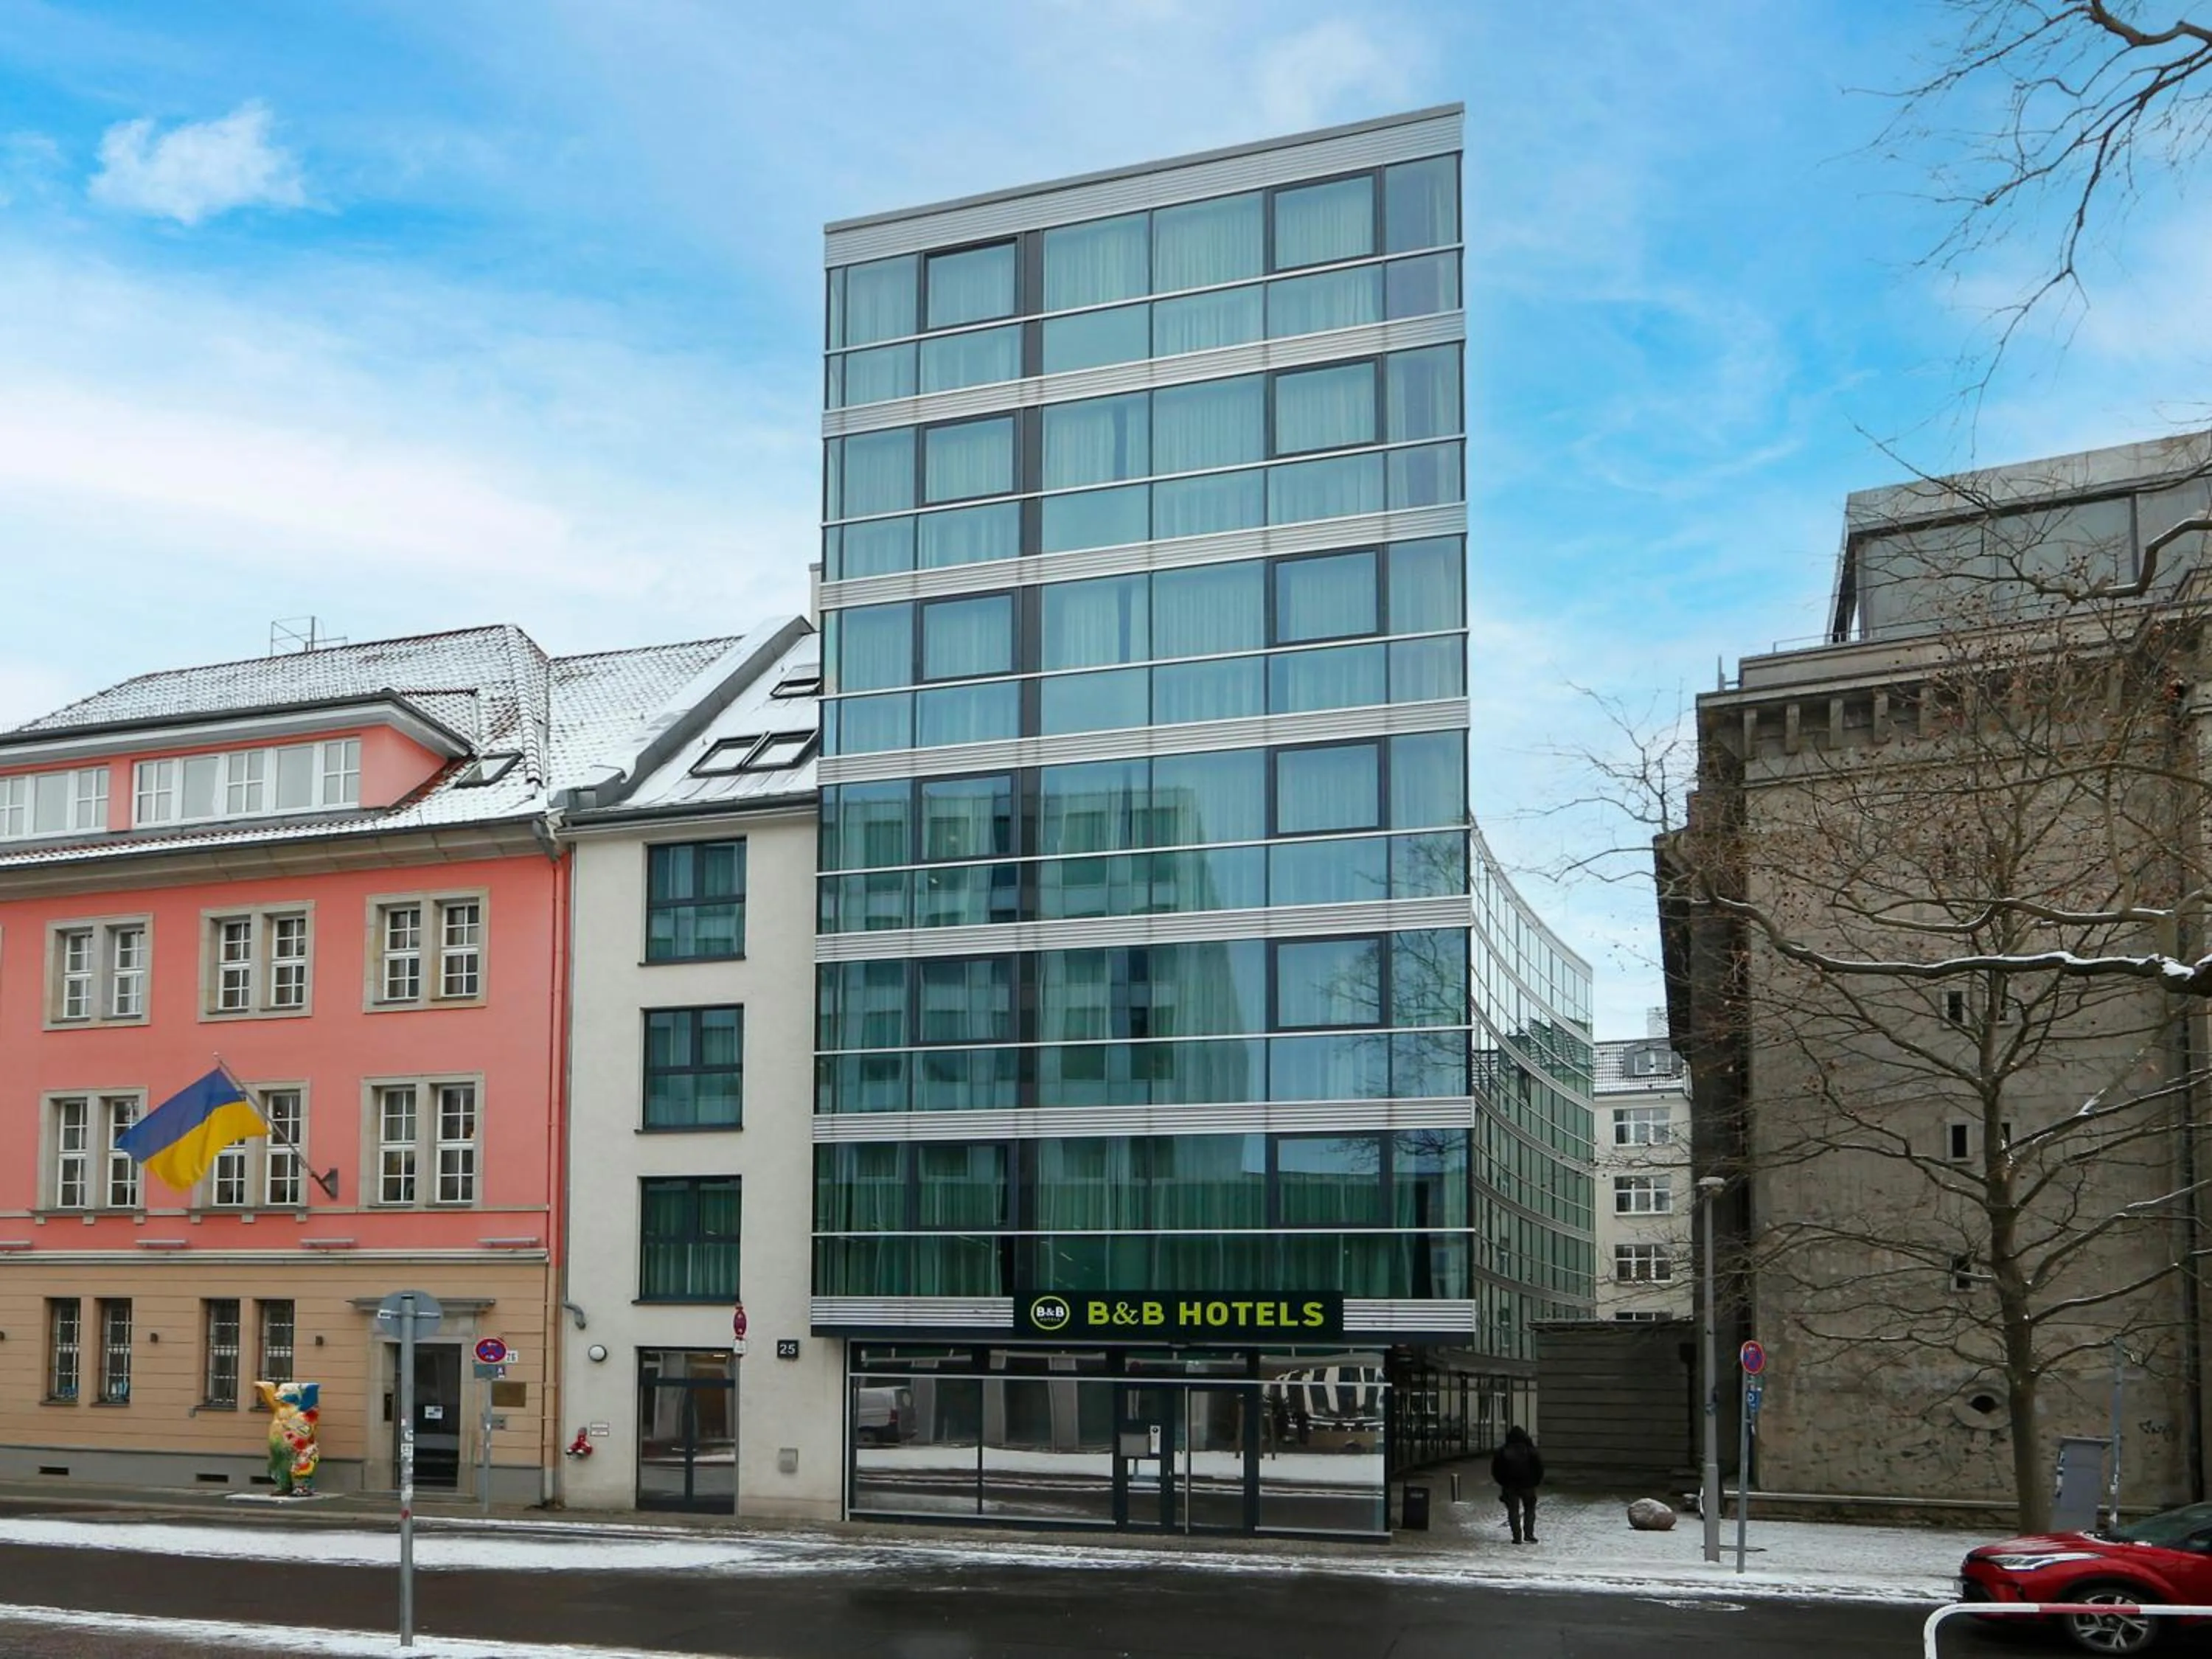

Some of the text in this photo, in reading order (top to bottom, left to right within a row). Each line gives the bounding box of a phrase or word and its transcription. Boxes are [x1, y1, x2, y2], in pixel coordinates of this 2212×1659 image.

[1036, 1306, 1064, 1317] B&B
[1088, 1301, 1324, 1326] B&B HOTELS
[779, 1343, 796, 1354] 25
